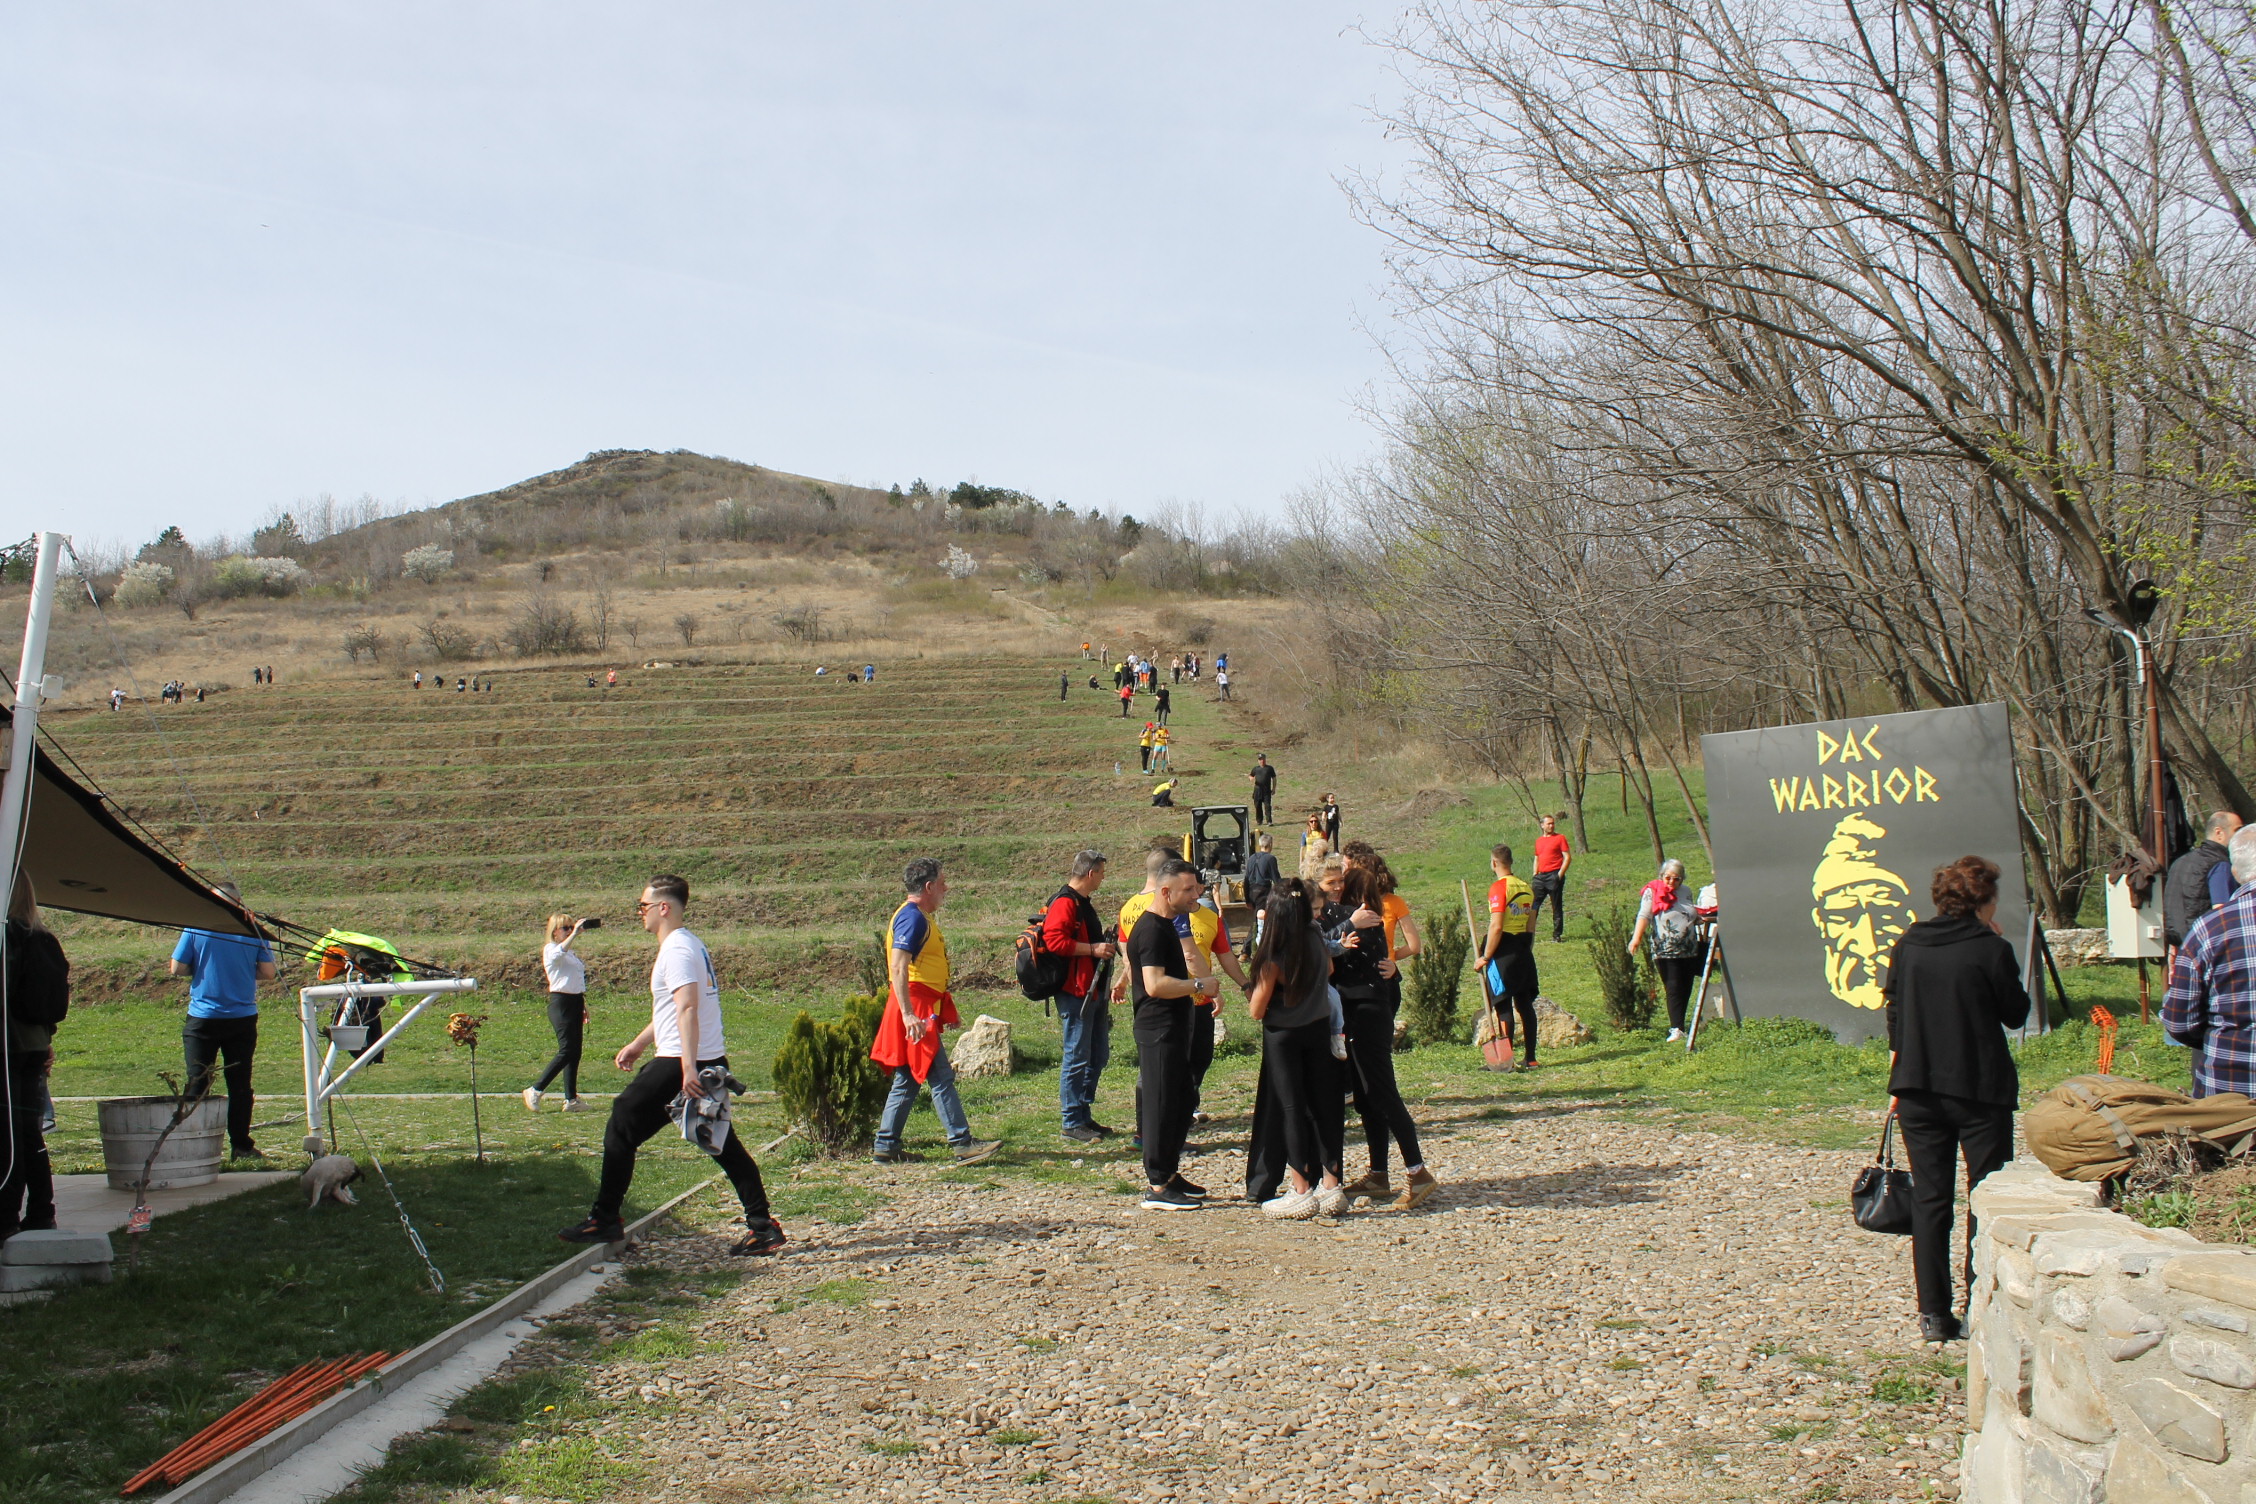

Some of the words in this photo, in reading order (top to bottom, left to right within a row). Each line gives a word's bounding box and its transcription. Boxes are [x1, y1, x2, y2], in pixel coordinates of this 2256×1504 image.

[1816, 723, 1883, 766] DAC
[1768, 765, 1940, 814] WARRIOR
[1132, 901, 1146, 912] DAC
